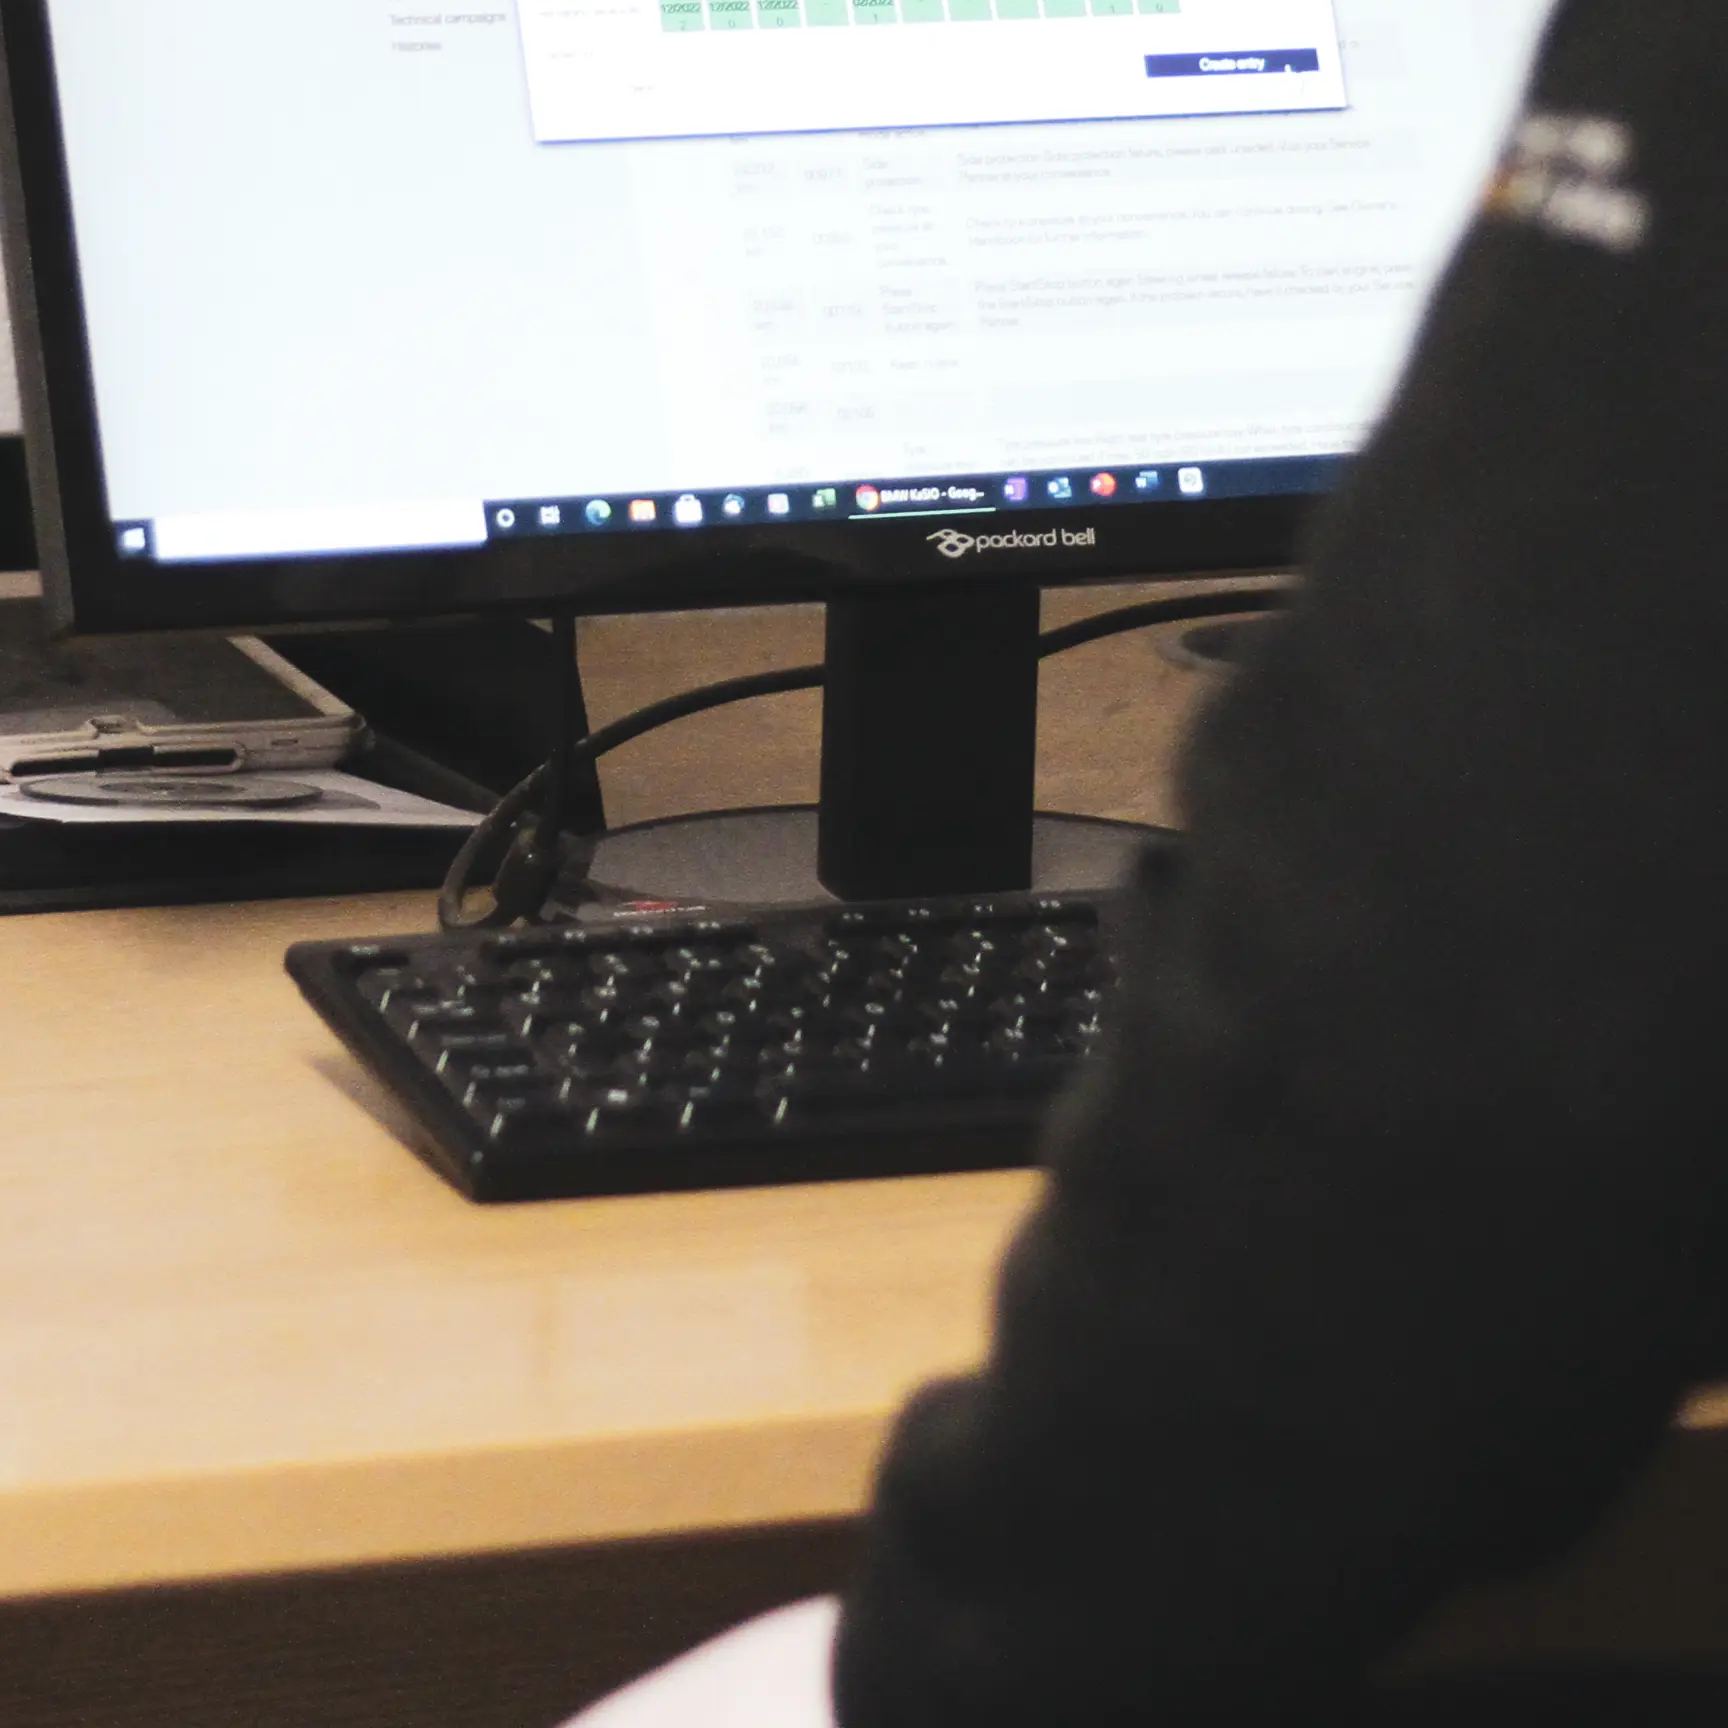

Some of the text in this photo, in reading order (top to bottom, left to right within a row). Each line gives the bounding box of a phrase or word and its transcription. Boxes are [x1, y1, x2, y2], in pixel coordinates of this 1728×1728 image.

[389, 12, 507, 27] Technical campaigns
[1198, 57, 1236, 72] Create
[880, 487, 909, 503] BMW
[976, 527, 1096, 552] packard bell
